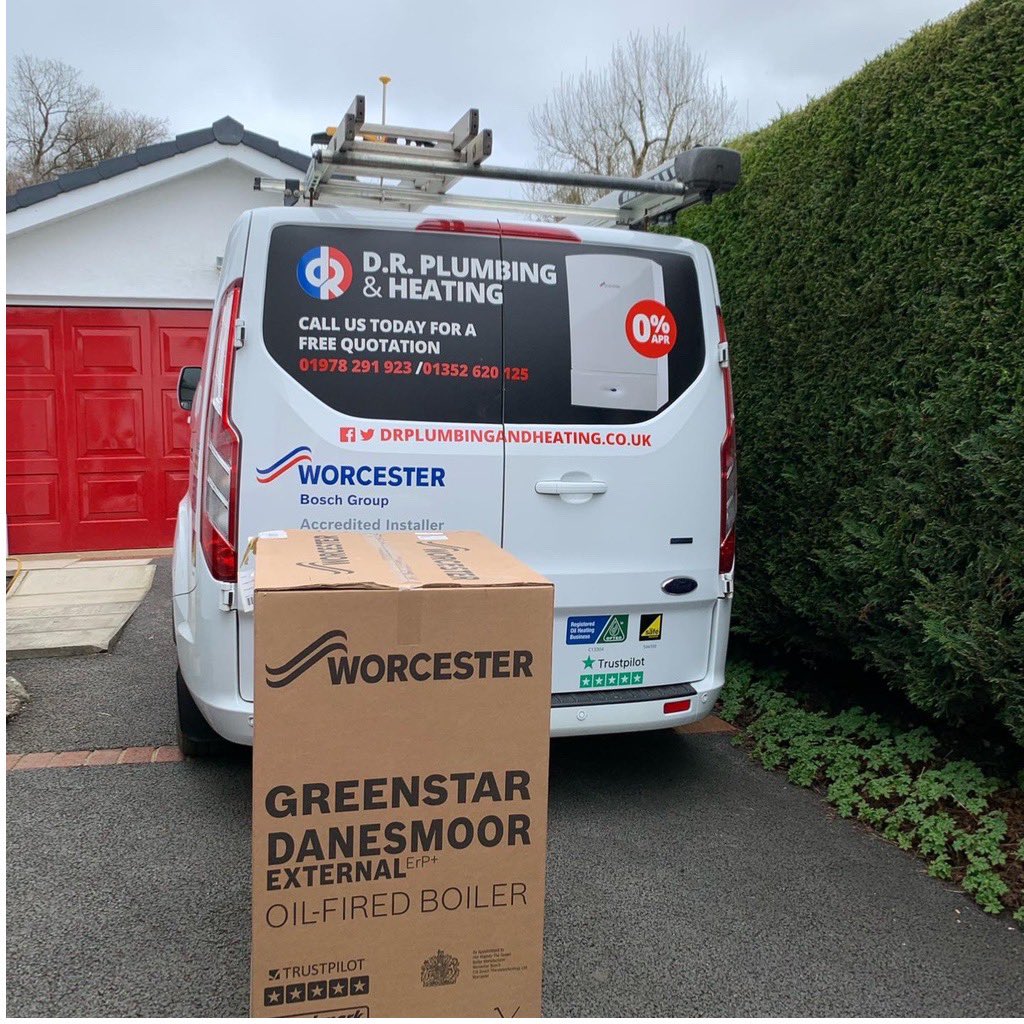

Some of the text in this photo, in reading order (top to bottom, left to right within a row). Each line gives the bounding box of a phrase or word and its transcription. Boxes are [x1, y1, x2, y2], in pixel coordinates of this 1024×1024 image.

[362, 251, 557, 285] D.R. PLUMBING
[362, 275, 504, 305] & HEATING
[298, 316, 478, 337] CALL US TODAY FOR A
[632, 313, 671, 343] 0%
[298, 336, 441, 355] FREE QUOTATION
[650, 334, 671, 345] APR
[298, 358, 348, 373] 01978
[351, 360, 380, 374] 291
[383, 361, 412, 375] 923
[472, 365, 500, 379] 620
[503, 367, 530, 382] 125
[379, 428, 653, 448] DRPLUMBINGANDHEATING.CO.UK
[297, 464, 446, 488] WORCESTER
[299, 493, 390, 509] Bosch Group
[299, 517, 445, 533] Accredited Installer
[327, 650, 533, 685] WORCESTER
[598, 657, 645, 669] Trustpilot
[265, 770, 531, 818] GREENSTAR
[267, 814, 531, 866] DANESMOOR
[266, 858, 406, 891] EXTERNAL
[266, 882, 527, 928] OIL-FIRED BOILER
[283, 958, 365, 979] TRUSTPILOT
